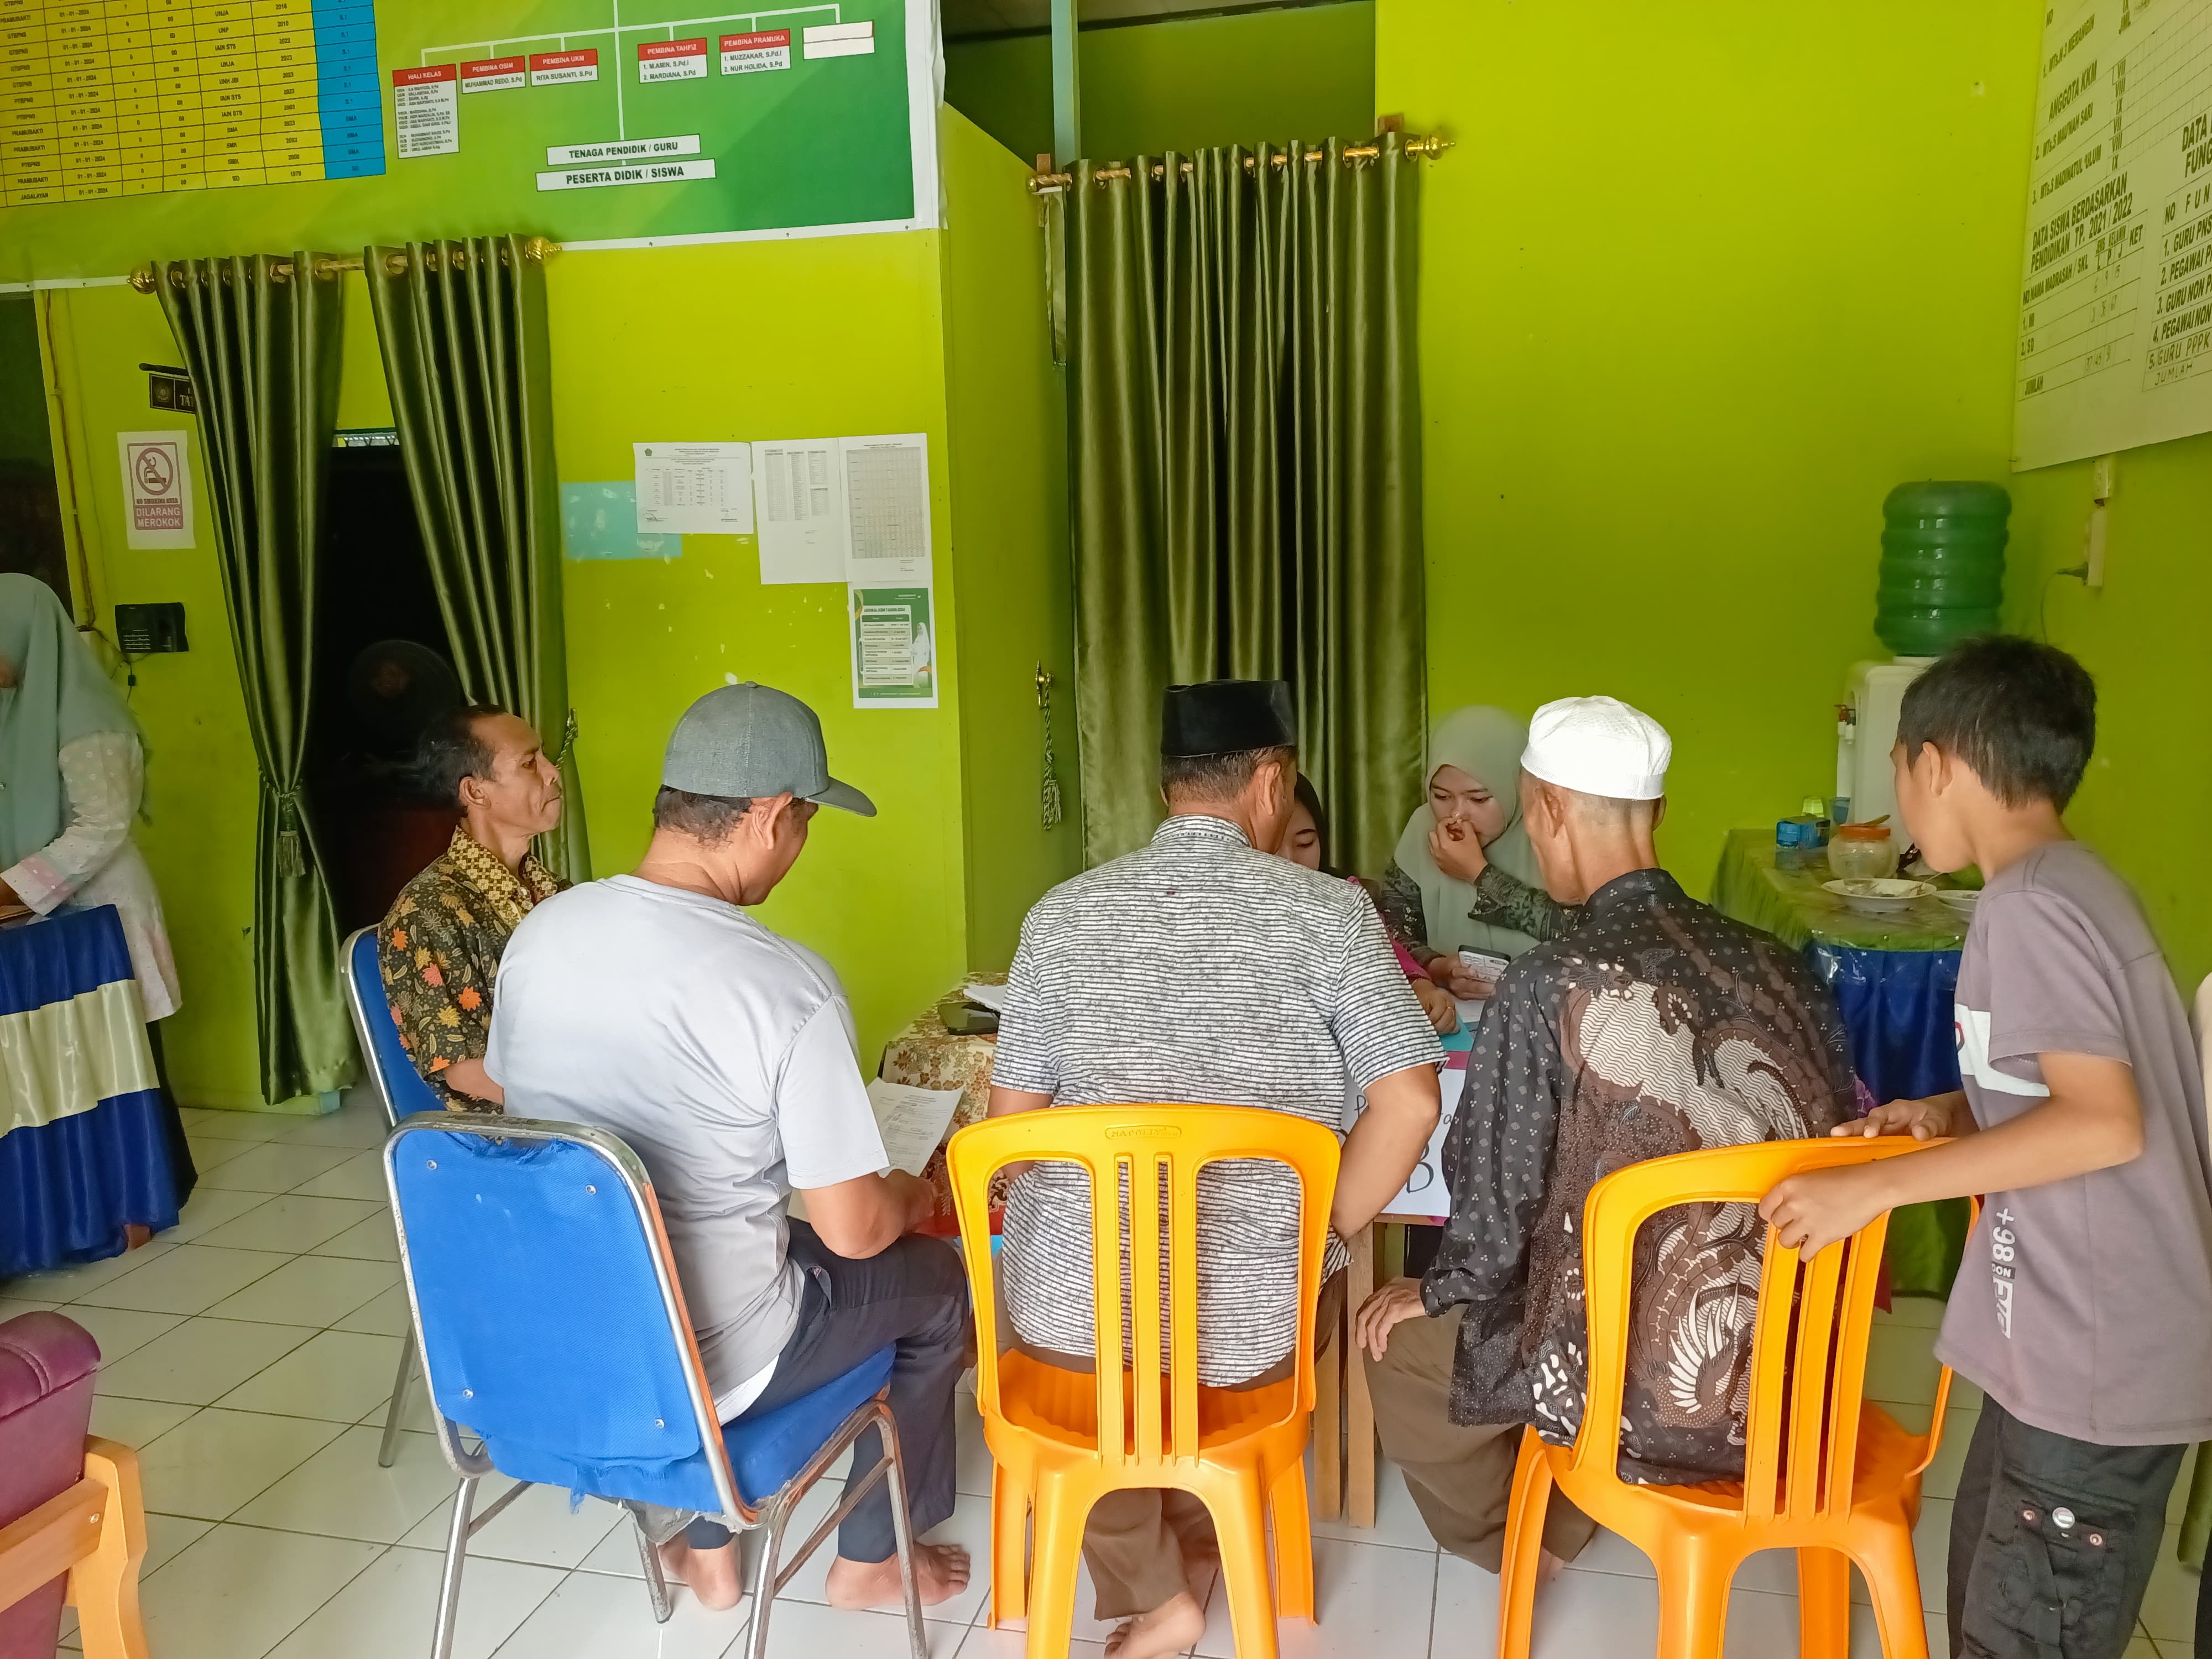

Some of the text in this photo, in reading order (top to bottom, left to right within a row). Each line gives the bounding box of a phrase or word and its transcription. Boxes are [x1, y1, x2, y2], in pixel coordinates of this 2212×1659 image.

[648, 45, 675, 54] PEMBINA
[754, 35, 785, 44] PRAMUKA
[2117, 59, 2126, 79] VII
[2048, 59, 2097, 122] ANGGOTA KKM
[2115, 77, 2126, 98] VIII
[2080, 102, 2093, 126] SARI
[2116, 97, 2123, 115] IX
[2114, 116, 2122, 134] VII
[2182, 113, 2206, 152] DATA
[569, 149, 604, 159] TENAGA
[606, 144, 647, 155] PENDIDIK
[654, 142, 678, 152] GURU
[2112, 132, 2122, 153] VIII
[2112, 154, 2119, 171] IX
[566, 171, 612, 185] PESERTA
[614, 169, 643, 181] DIDIK
[651, 166, 684, 178] SISWA
[2033, 171, 2127, 251] DATA SISWA BERDASARKAN
[2165, 202, 2176, 225] NO
[2031, 232, 2070, 274] PENDIDIKAN
[2075, 223, 2085, 247] TP.
[2089, 208, 2106, 239] 2021
[2112, 192, 2133, 225] 2022
[2174, 224, 2195, 252] GURU
[2197, 215, 2212, 240] PNS
[2107, 249, 2111, 266] P
[2118, 243, 2122, 258] J
[2130, 225, 2143, 247] KET
[2030, 281, 2044, 301] NAMA
[2046, 264, 2073, 293] MADRASAH
[2078, 254, 2088, 274] SKL
[2161, 267, 2167, 286] 2.
[2169, 248, 2204, 282] PEGAWAI
[2157, 296, 2163, 315] 3.
[2166, 286, 2187, 312] GURU
[2187, 277, 2205, 303] NON
[2161, 310, 2195, 341] PEGAWAI
[2194, 302, 2212, 328] NON
[2027, 338, 2034, 354] SD
[2158, 342, 2182, 365] GURU
[2186, 331, 2210, 356] PPPK
[137, 507, 180, 517] DILARANG
[138, 518, 181, 527] MEROKOK
